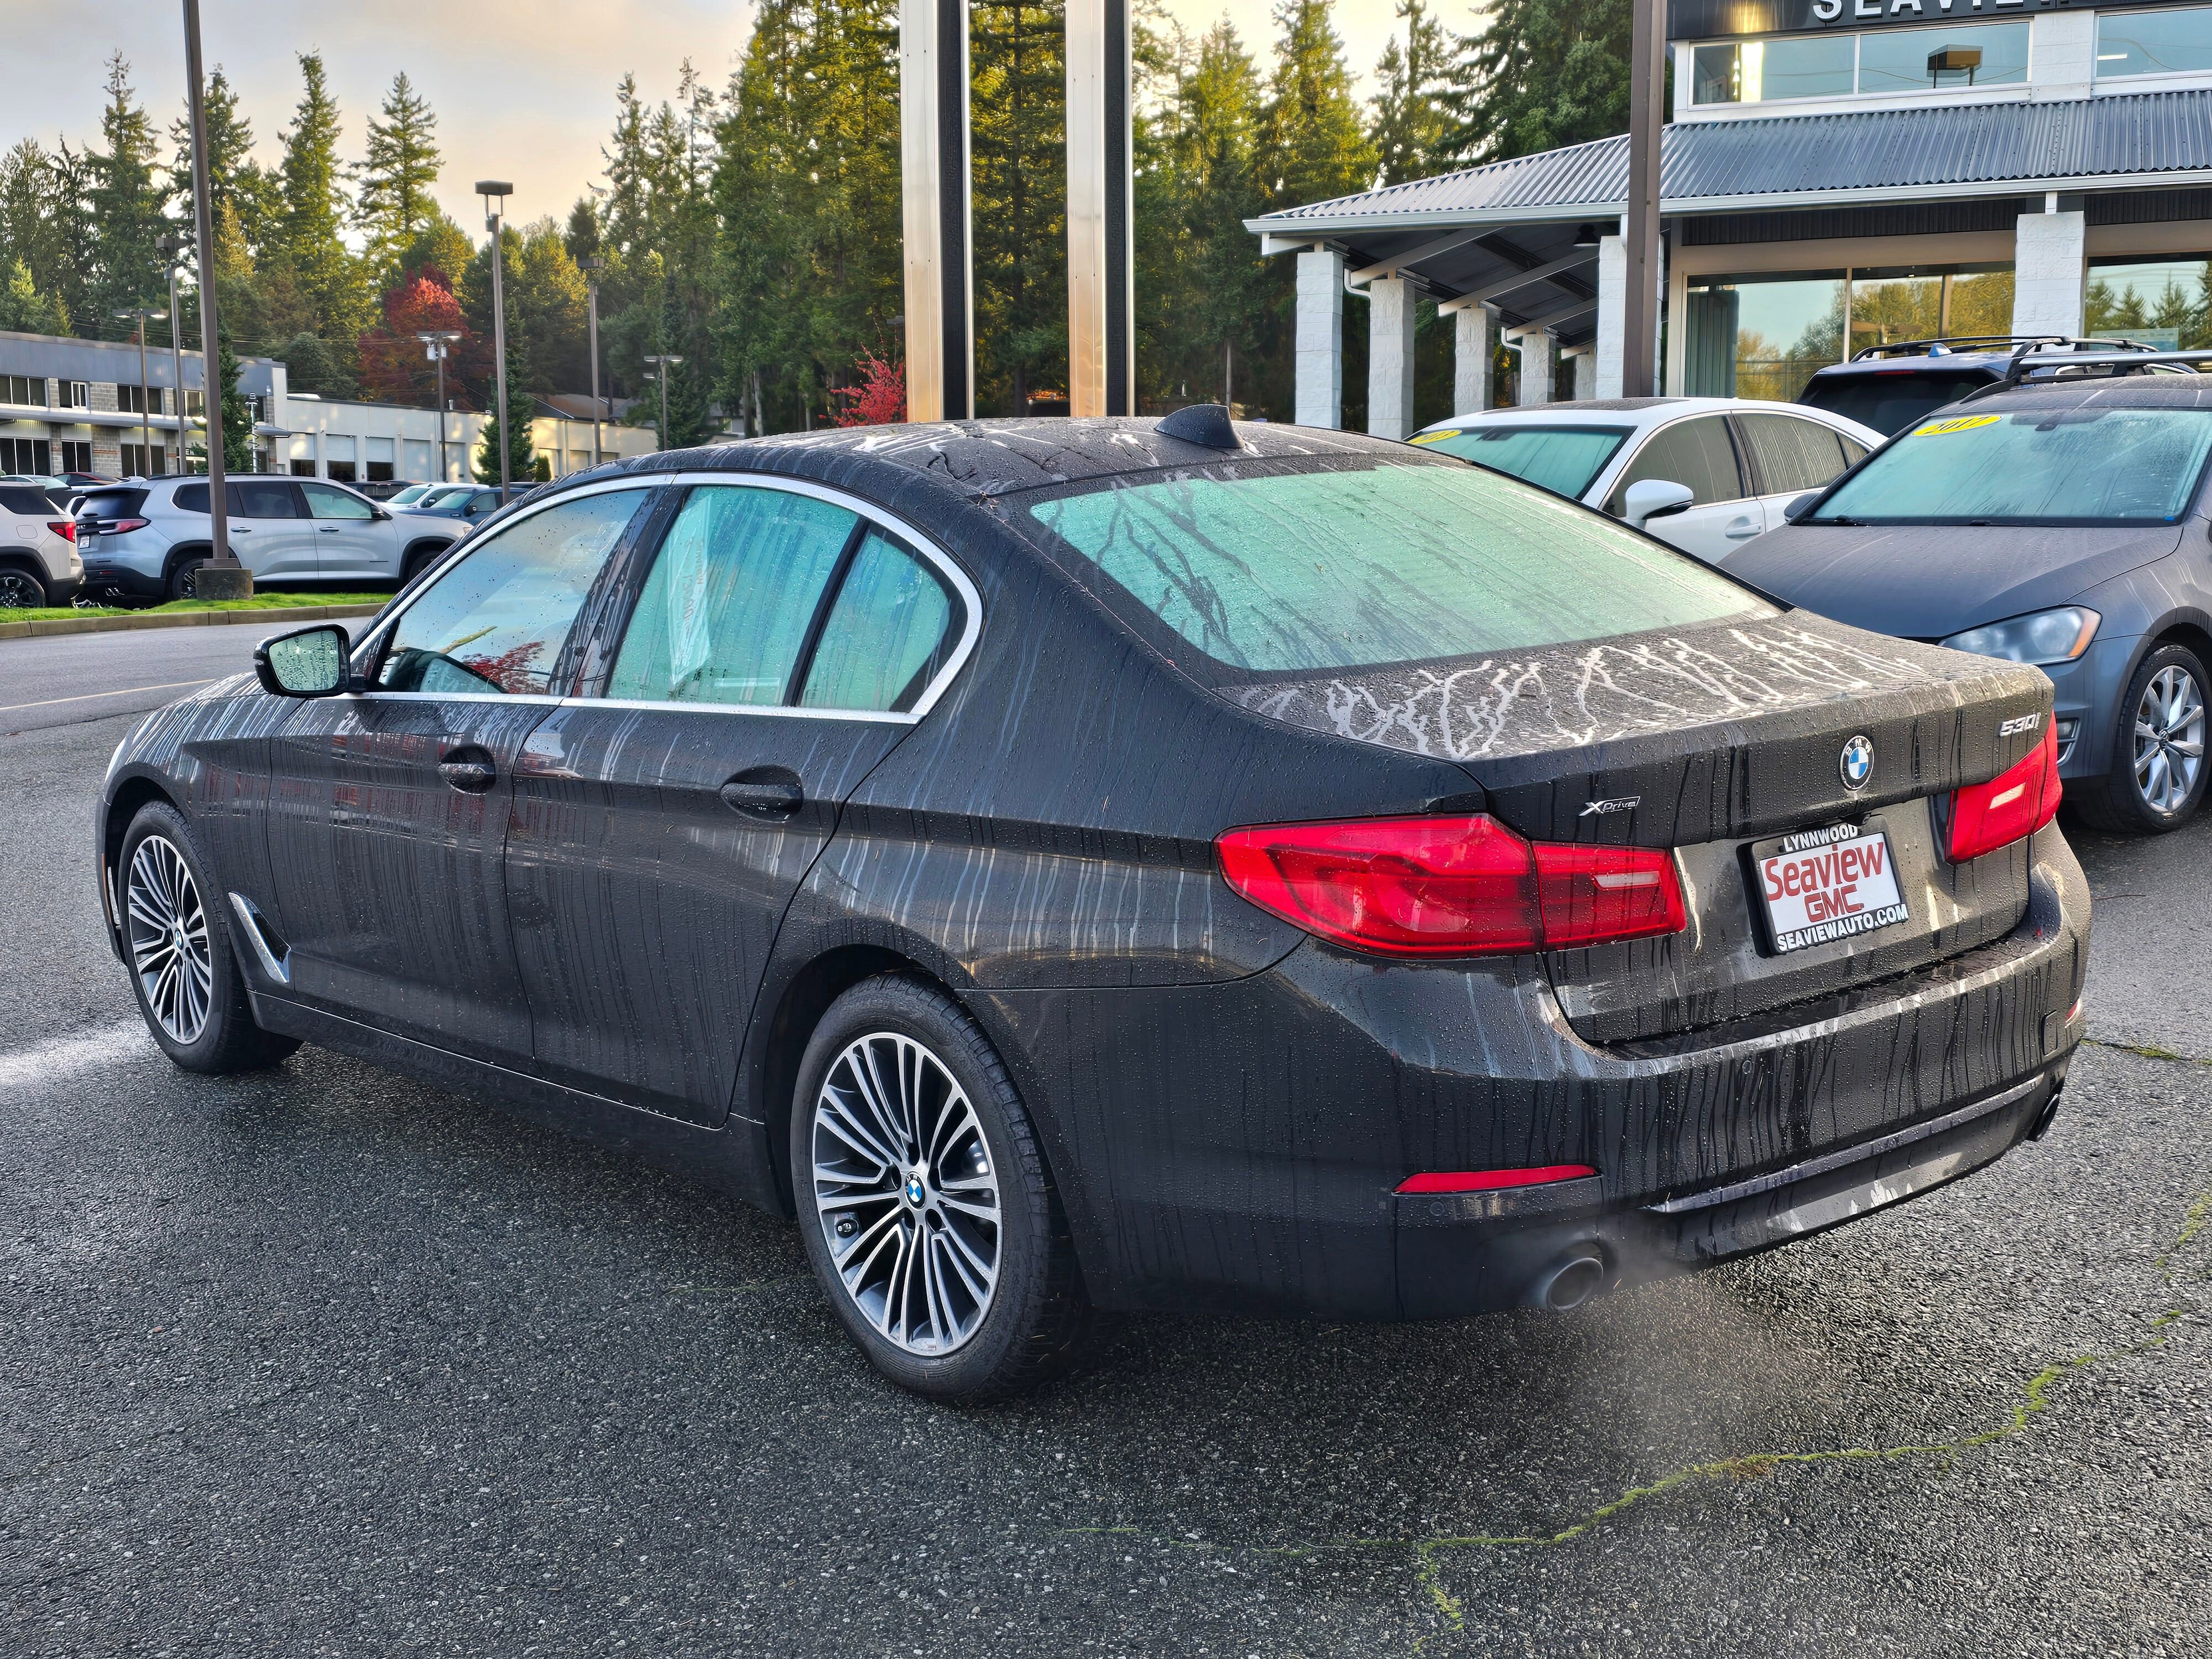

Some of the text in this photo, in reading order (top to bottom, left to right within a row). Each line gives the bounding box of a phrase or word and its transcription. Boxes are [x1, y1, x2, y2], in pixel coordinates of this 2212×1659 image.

[2000, 712, 2041, 737] 530i
[1845, 738, 1872, 757] BMW
[1783, 824, 1858, 852] LYNNWOOD
[1765, 842, 1884, 901] Seaview
[1804, 884, 1865, 923] GMC
[1777, 904, 1909, 951] SEAVIEWAUTO.COM
